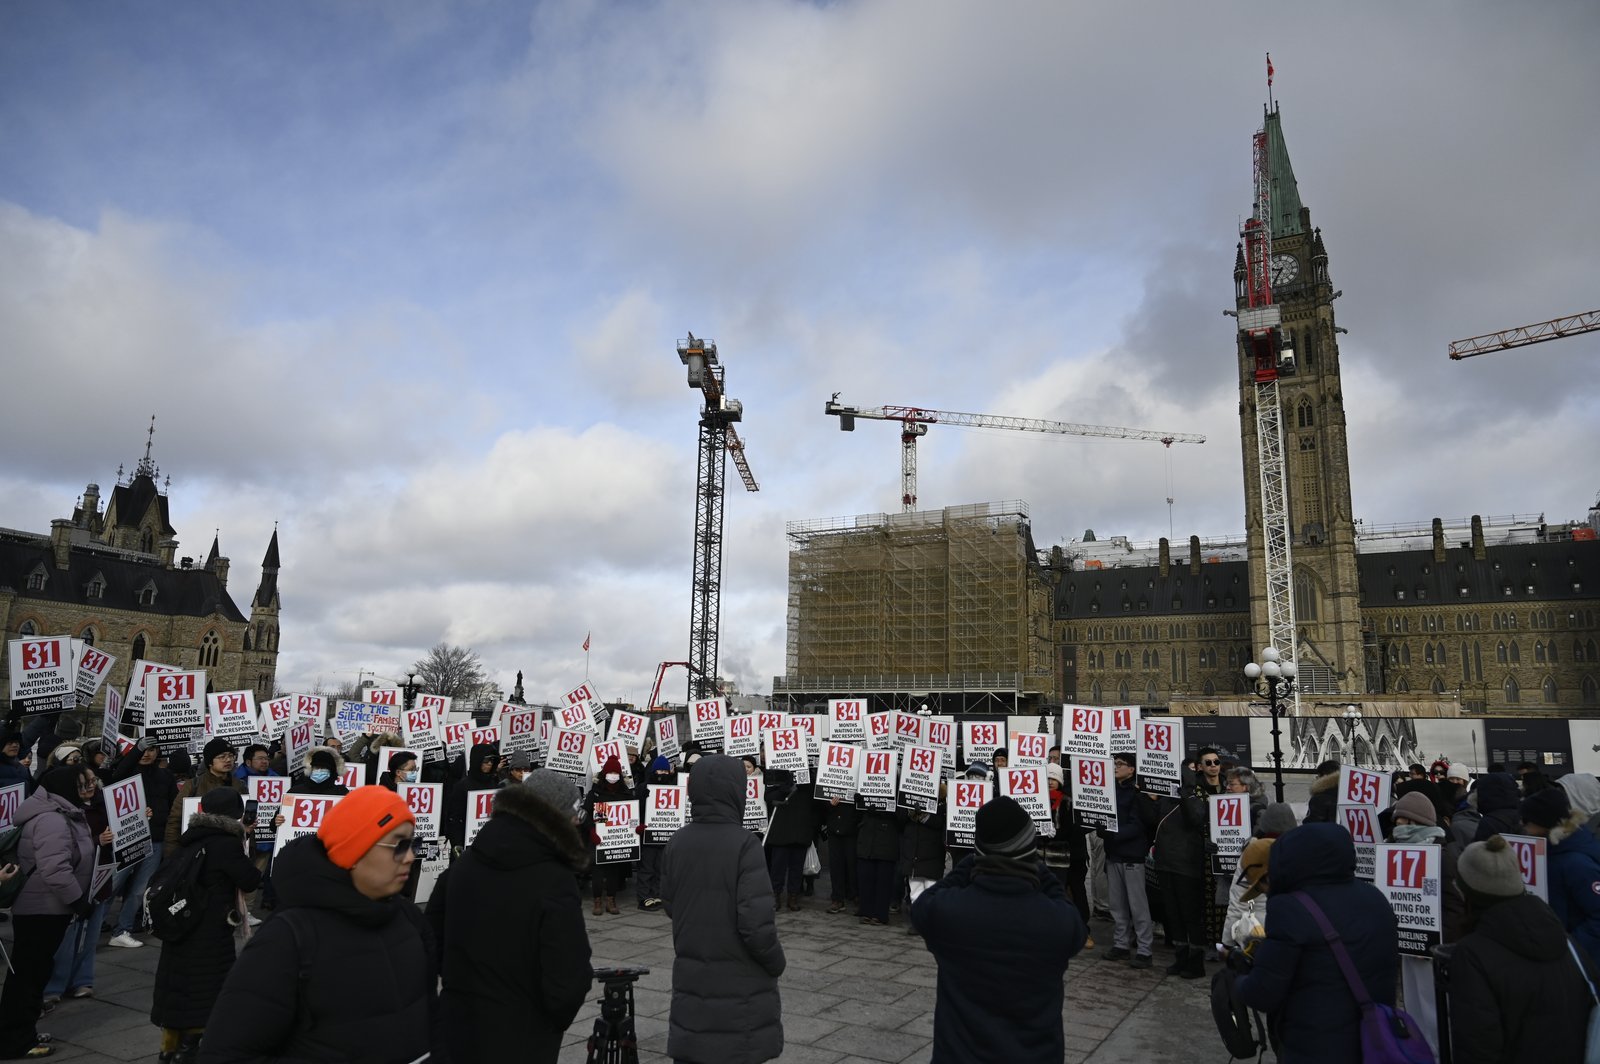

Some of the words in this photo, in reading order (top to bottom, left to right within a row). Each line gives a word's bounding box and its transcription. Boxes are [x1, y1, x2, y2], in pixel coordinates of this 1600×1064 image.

[27, 641, 56, 669] 31
[83, 652, 105, 673] 31
[20, 679, 49, 688] WAITING
[27, 671, 57, 679] MONTHS
[33, 684, 68, 694] RESPONSE
[162, 676, 190, 700] 31
[374, 691, 393, 704] 27
[154, 710, 182, 718] WAITING
[221, 695, 241, 714] 27
[301, 697, 318, 716] 25
[342, 702, 366, 711] STOP
[369, 705, 389, 715] THE
[564, 704, 583, 724] 30
[699, 702, 718, 720] 38
[839, 703, 857, 720] 34
[166, 716, 201, 724] RESPONSE
[410, 711, 430, 731] 29
[513, 714, 532, 733] 68
[621, 715, 640, 734] 33
[660, 720, 673, 739] 30
[732, 718, 750, 736] 40
[899, 716, 917, 737] 22
[1075, 710, 1099, 732] 30
[294, 725, 308, 748] 22
[412, 731, 430, 739] MONTHS
[561, 733, 582, 752] 68
[776, 730, 795, 750] 53
[931, 724, 948, 744] 40
[974, 726, 994, 744] 33
[1147, 725, 1168, 750] 33
[600, 742, 617, 764] 30
[1020, 736, 1042, 757] 46
[831, 747, 850, 766] 15
[869, 754, 886, 774] 71
[913, 750, 931, 772] 53
[1082, 761, 1102, 786] 39
[1151, 768, 1177, 776] RESPONSE
[260, 781, 280, 802] 35
[830, 779, 855, 788] RESPONSE
[913, 786, 935, 794] RESPONSE
[1012, 770, 1035, 794] 23
[1350, 772, 1376, 805] 35
[116, 784, 136, 816] 20
[409, 788, 432, 813] 39
[658, 790, 676, 808] 51
[959, 784, 981, 806] 34
[297, 800, 326, 827] 31
[608, 804, 628, 825] 40
[1087, 803, 1112, 811] RESPONSE
[1220, 800, 1238, 825] 27
[121, 814, 138, 826] MONTHS
[1350, 810, 1373, 842] 22
[116, 823, 135, 837] WAITING
[1392, 851, 1420, 886] 17
[1390, 891, 1422, 902] MONTHS
[1415, 905, 1431, 914] FOR
[1398, 940, 1426, 950] RESULTS
